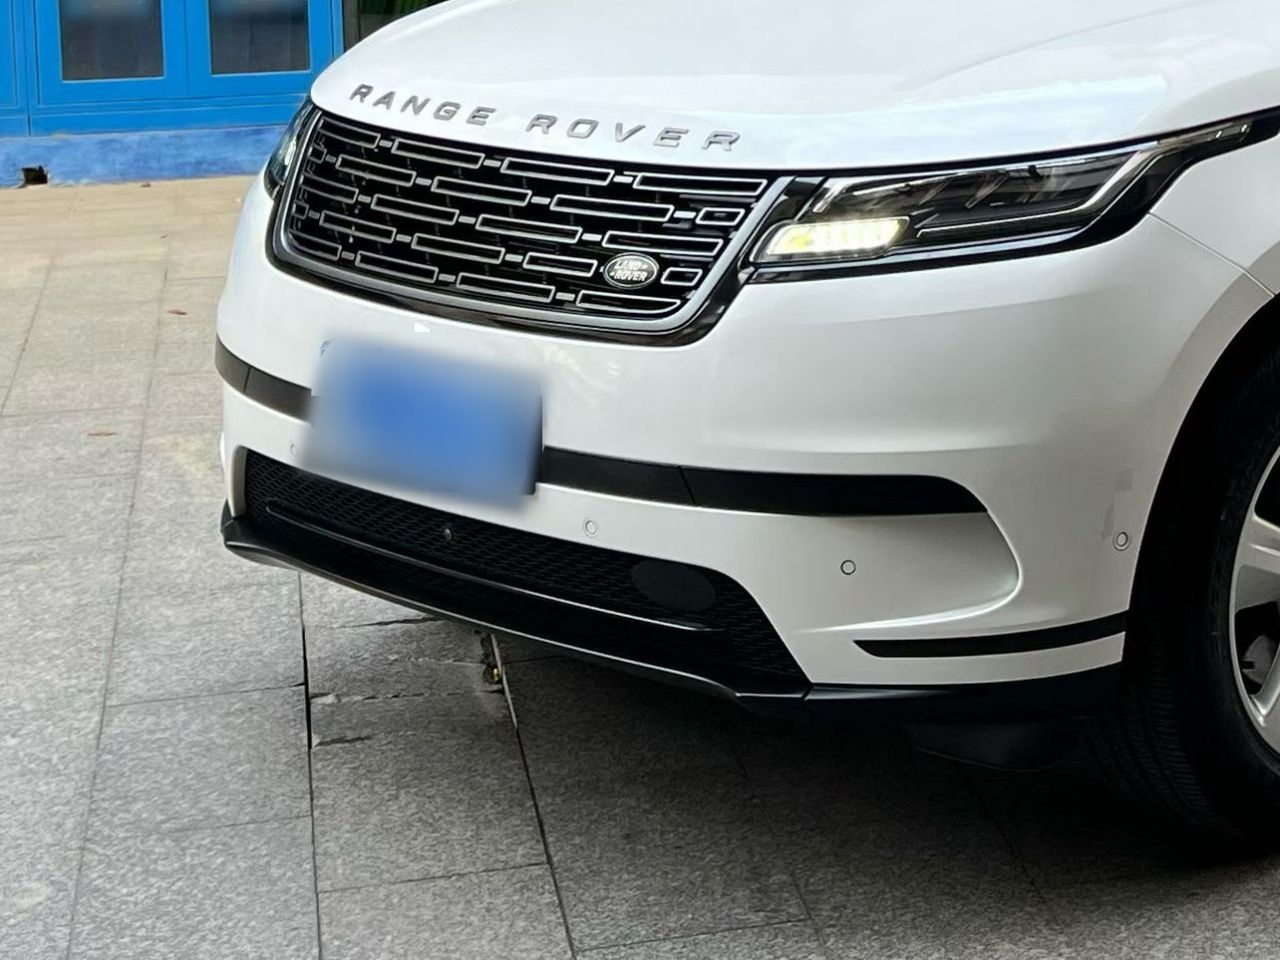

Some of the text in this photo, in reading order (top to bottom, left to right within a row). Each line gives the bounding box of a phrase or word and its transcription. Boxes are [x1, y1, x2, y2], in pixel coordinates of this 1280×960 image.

[349, 83, 741, 152] RANGE ROVER
[614, 259, 643, 271] LAND
[613, 269, 648, 282] ROVER
